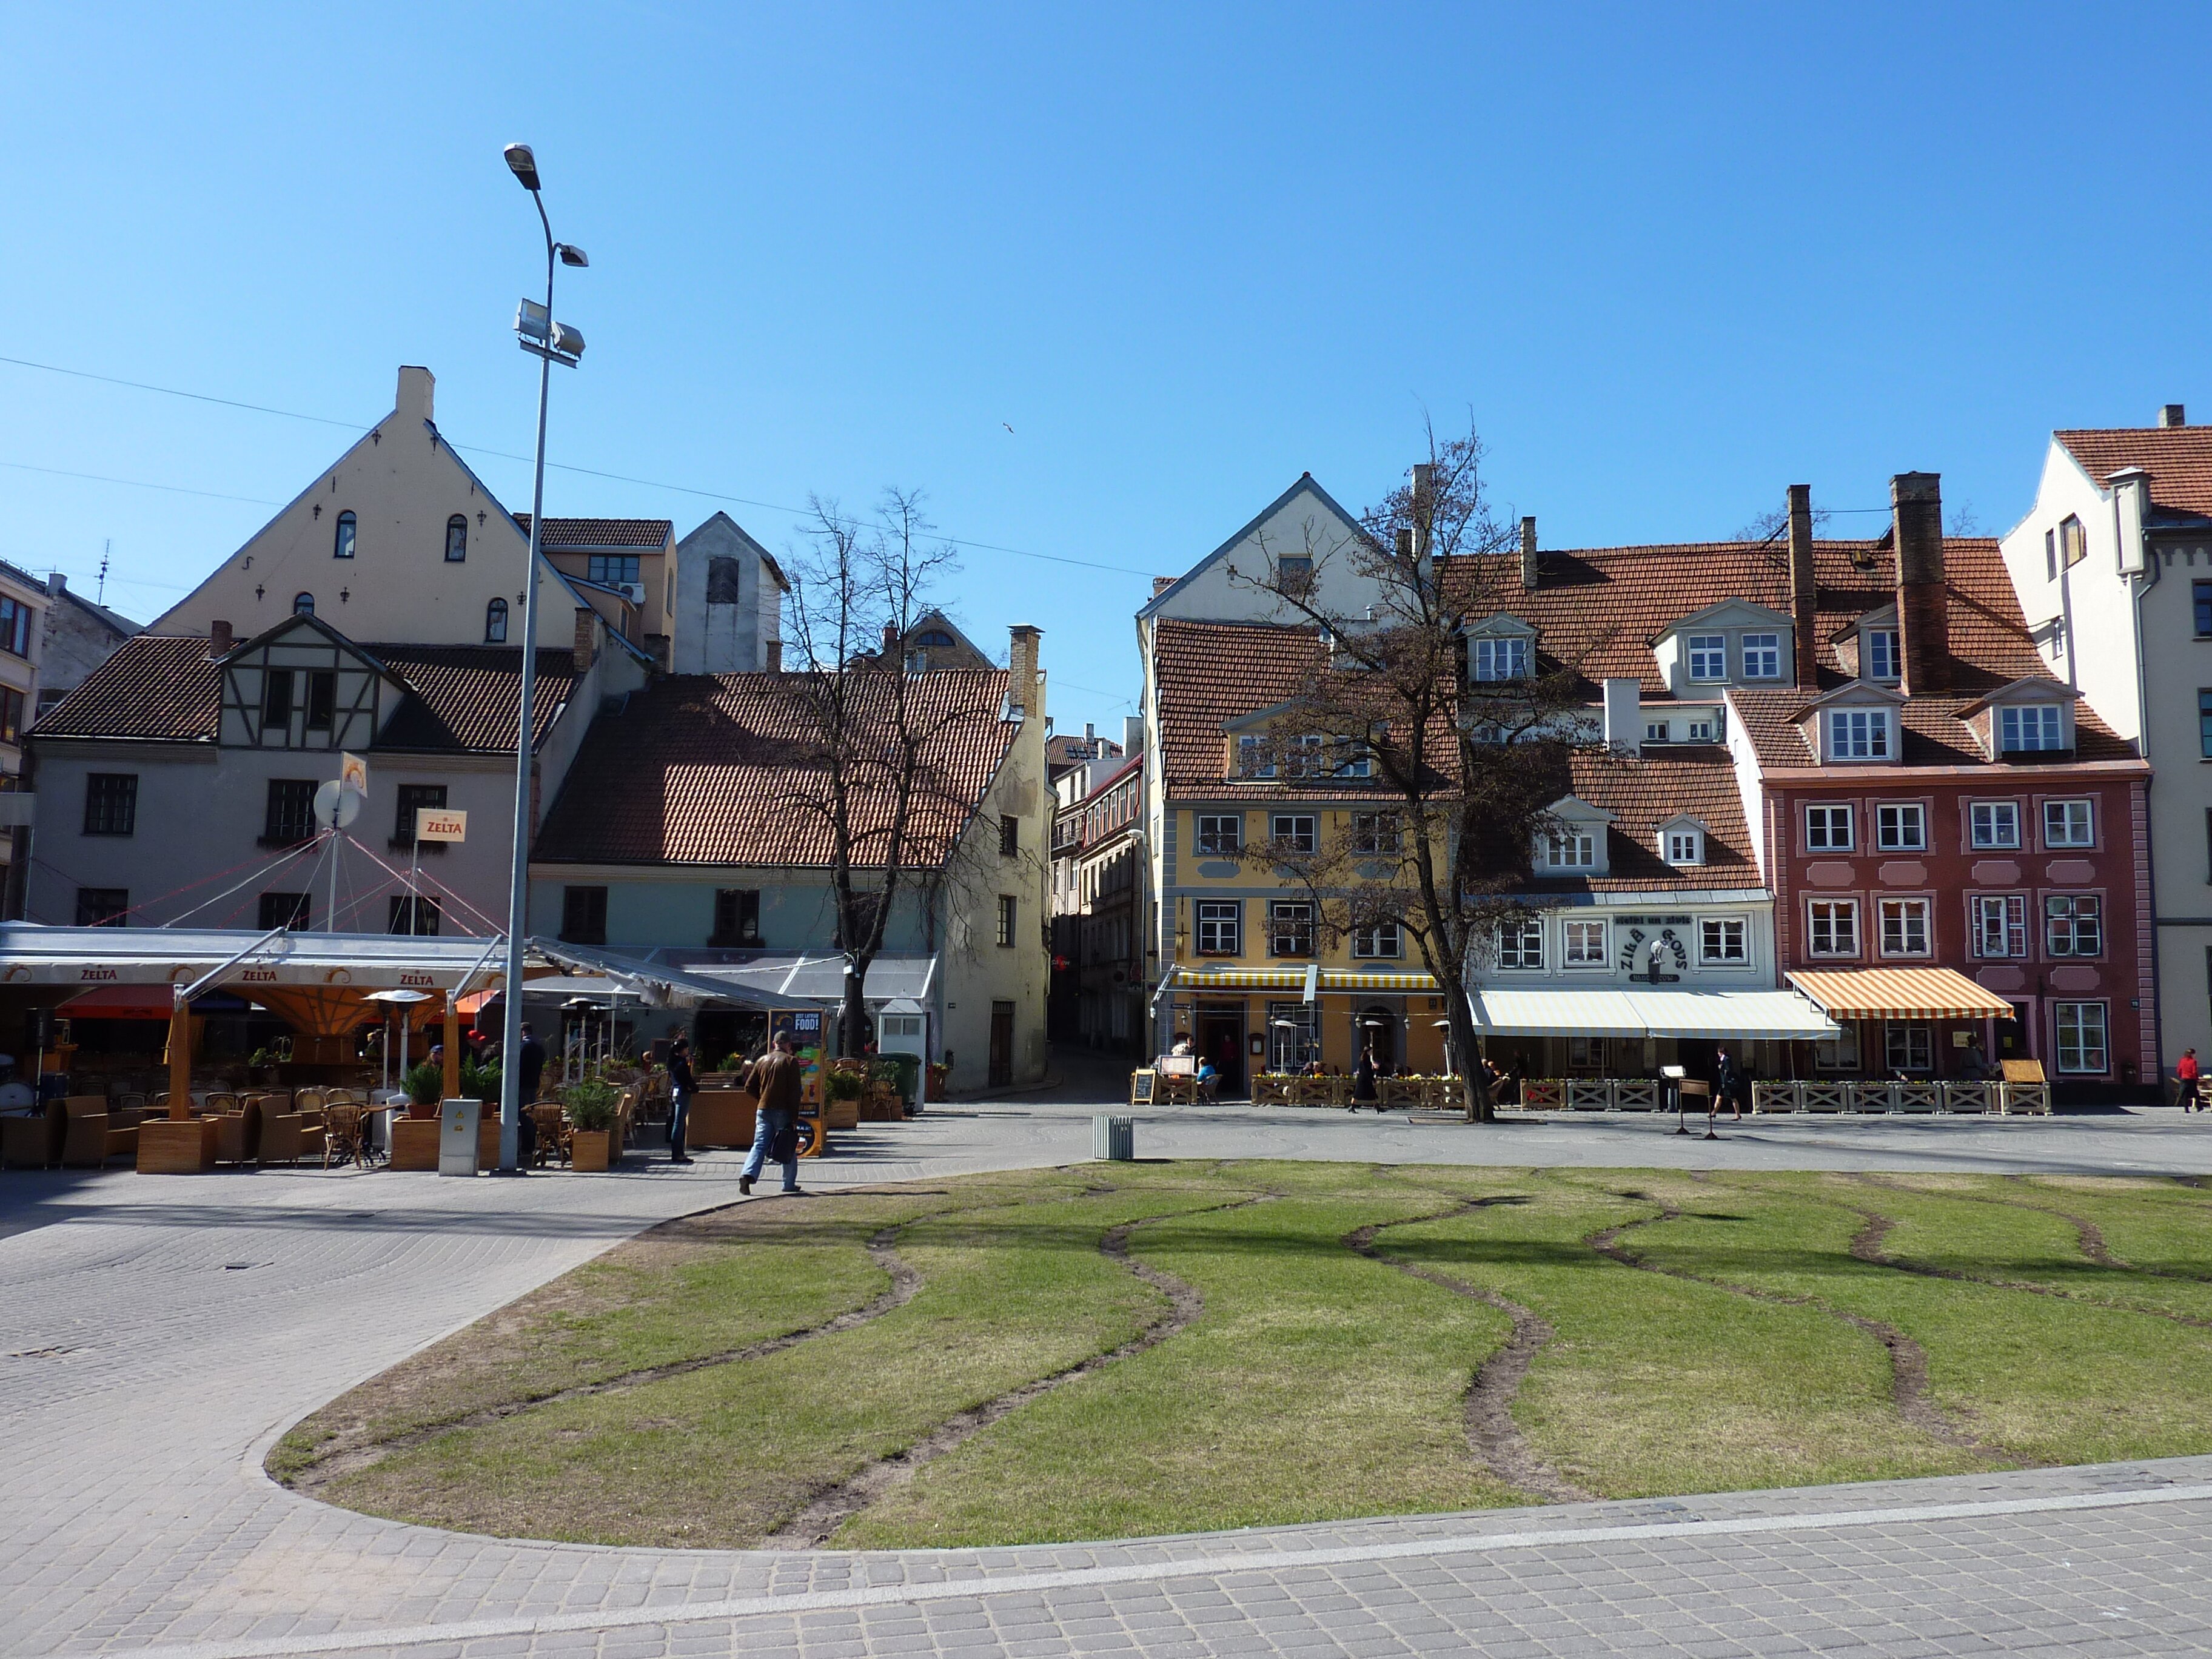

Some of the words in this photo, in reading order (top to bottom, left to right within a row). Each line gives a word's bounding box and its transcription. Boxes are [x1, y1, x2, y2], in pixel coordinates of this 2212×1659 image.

[427, 822, 462, 834] ZELTA
[81, 970, 117, 980] ZELTA
[243, 971, 276, 981] ZELTA
[400, 974, 434, 985] ZELTA
[795, 1019, 819, 1030] FOOD!
